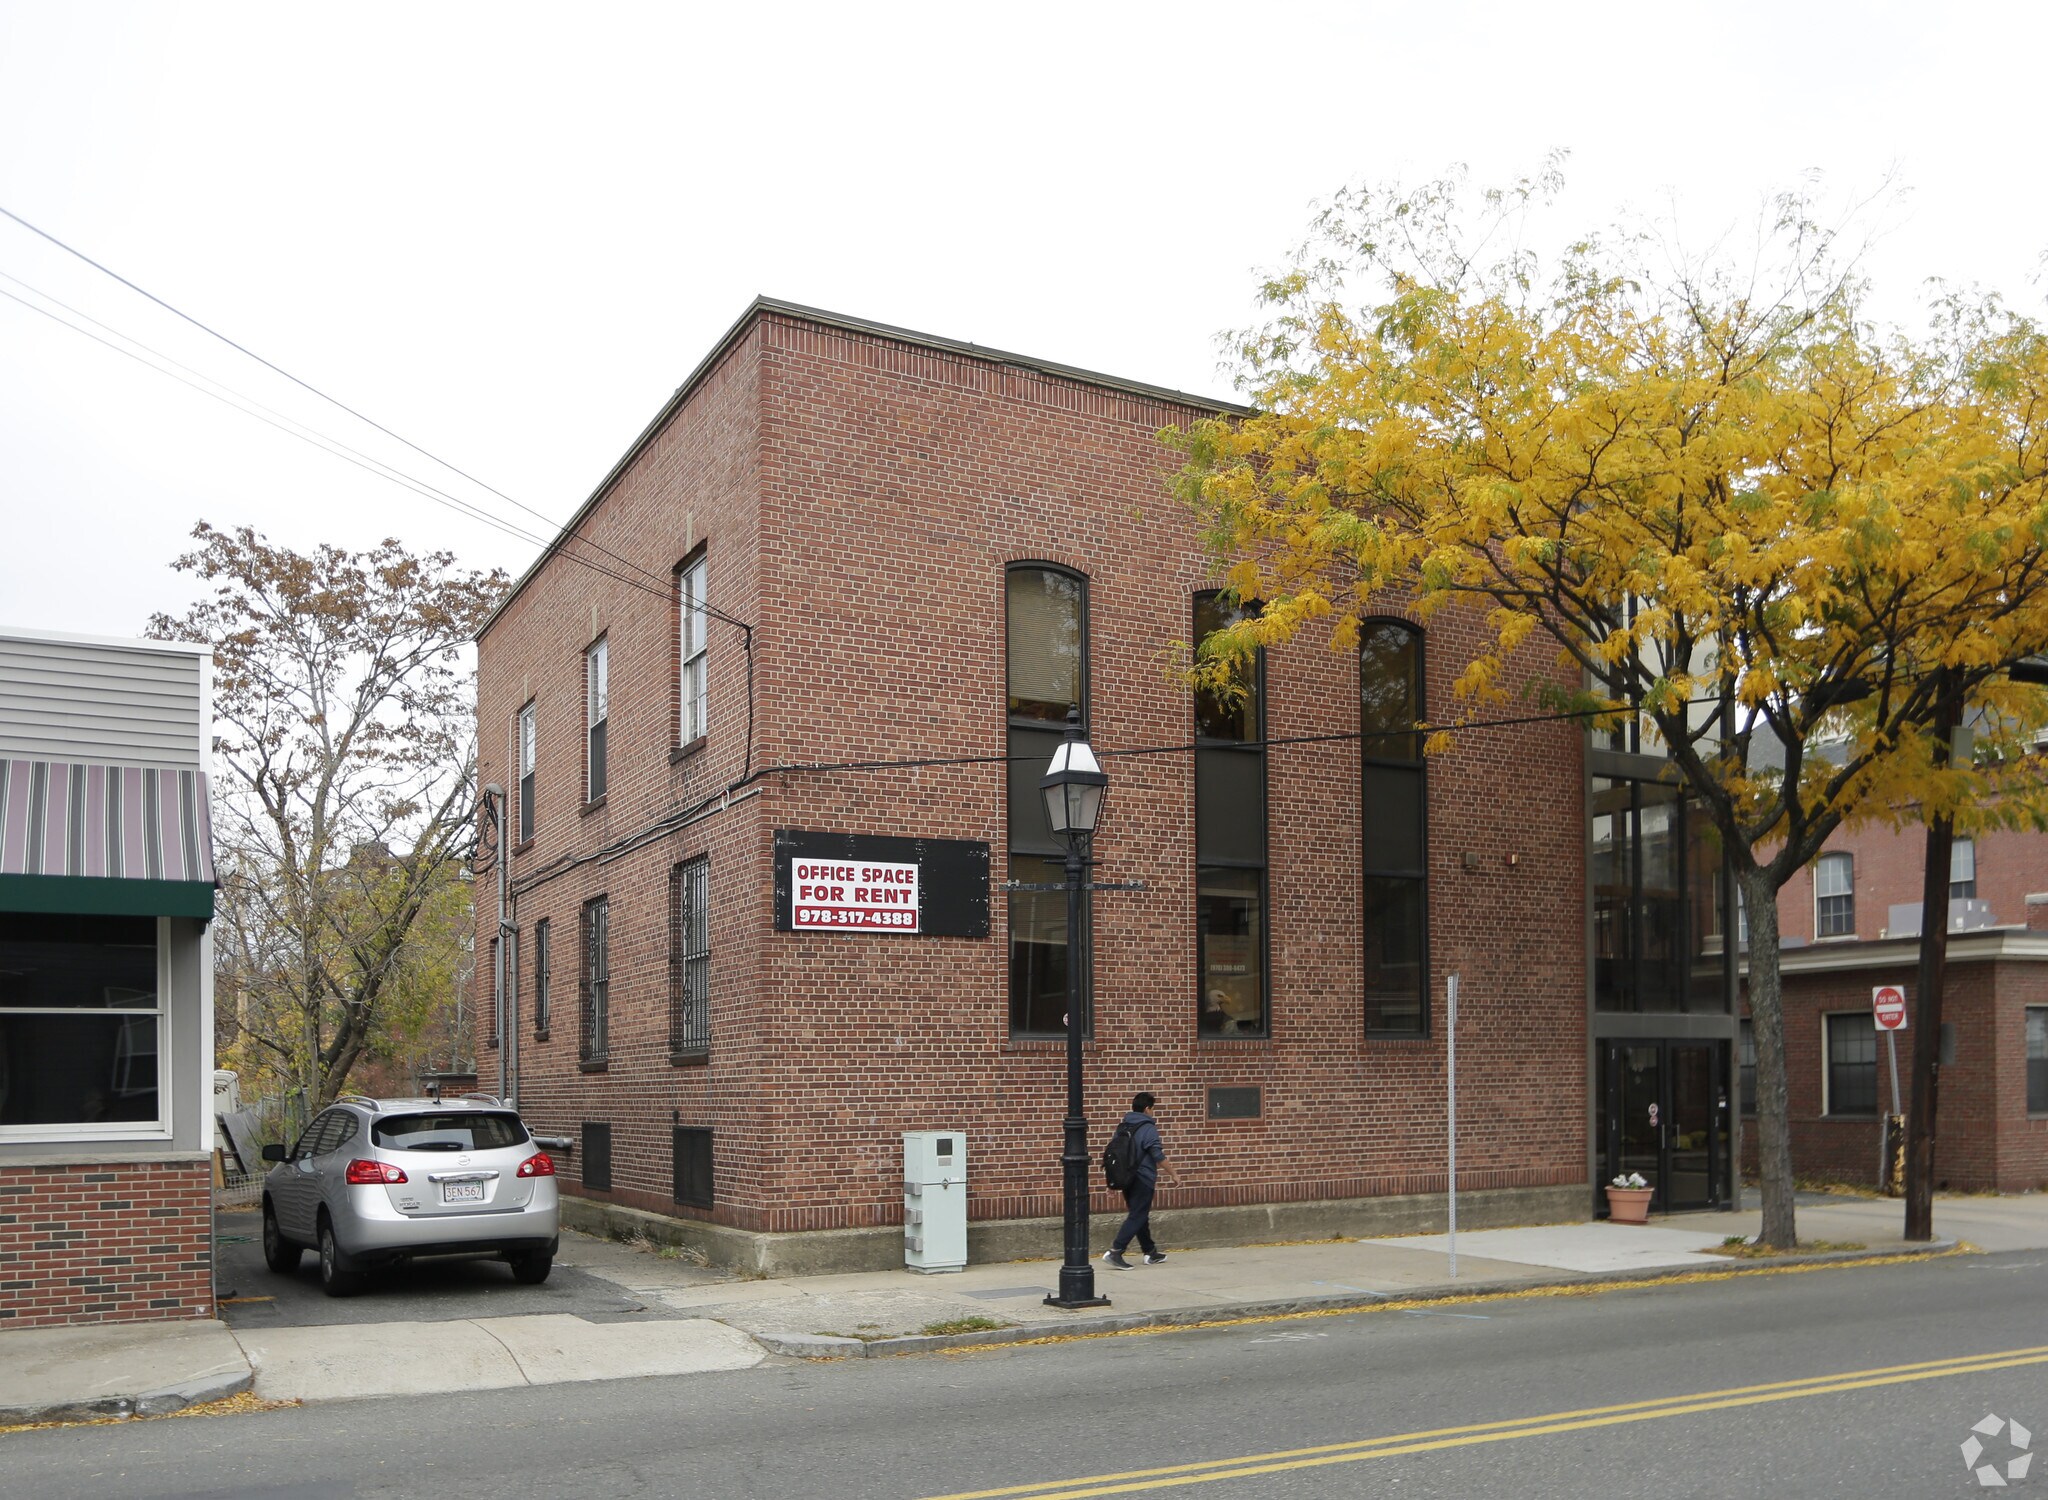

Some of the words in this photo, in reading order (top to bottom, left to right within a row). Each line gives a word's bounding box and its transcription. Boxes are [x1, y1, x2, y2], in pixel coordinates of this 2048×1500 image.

[797, 865, 855, 881] OFFICE
[861, 868, 914, 884] SPACE
[800, 885, 844, 902] FOR
[855, 887, 912, 904] RENT
[799, 909, 913, 926] 978-317-4388
[1888, 995, 1898, 1003] NOT
[1882, 1013, 1898, 1021] ENTER
[446, 1187, 463, 1198] 3EN
[464, 1186, 481, 1197] 567
